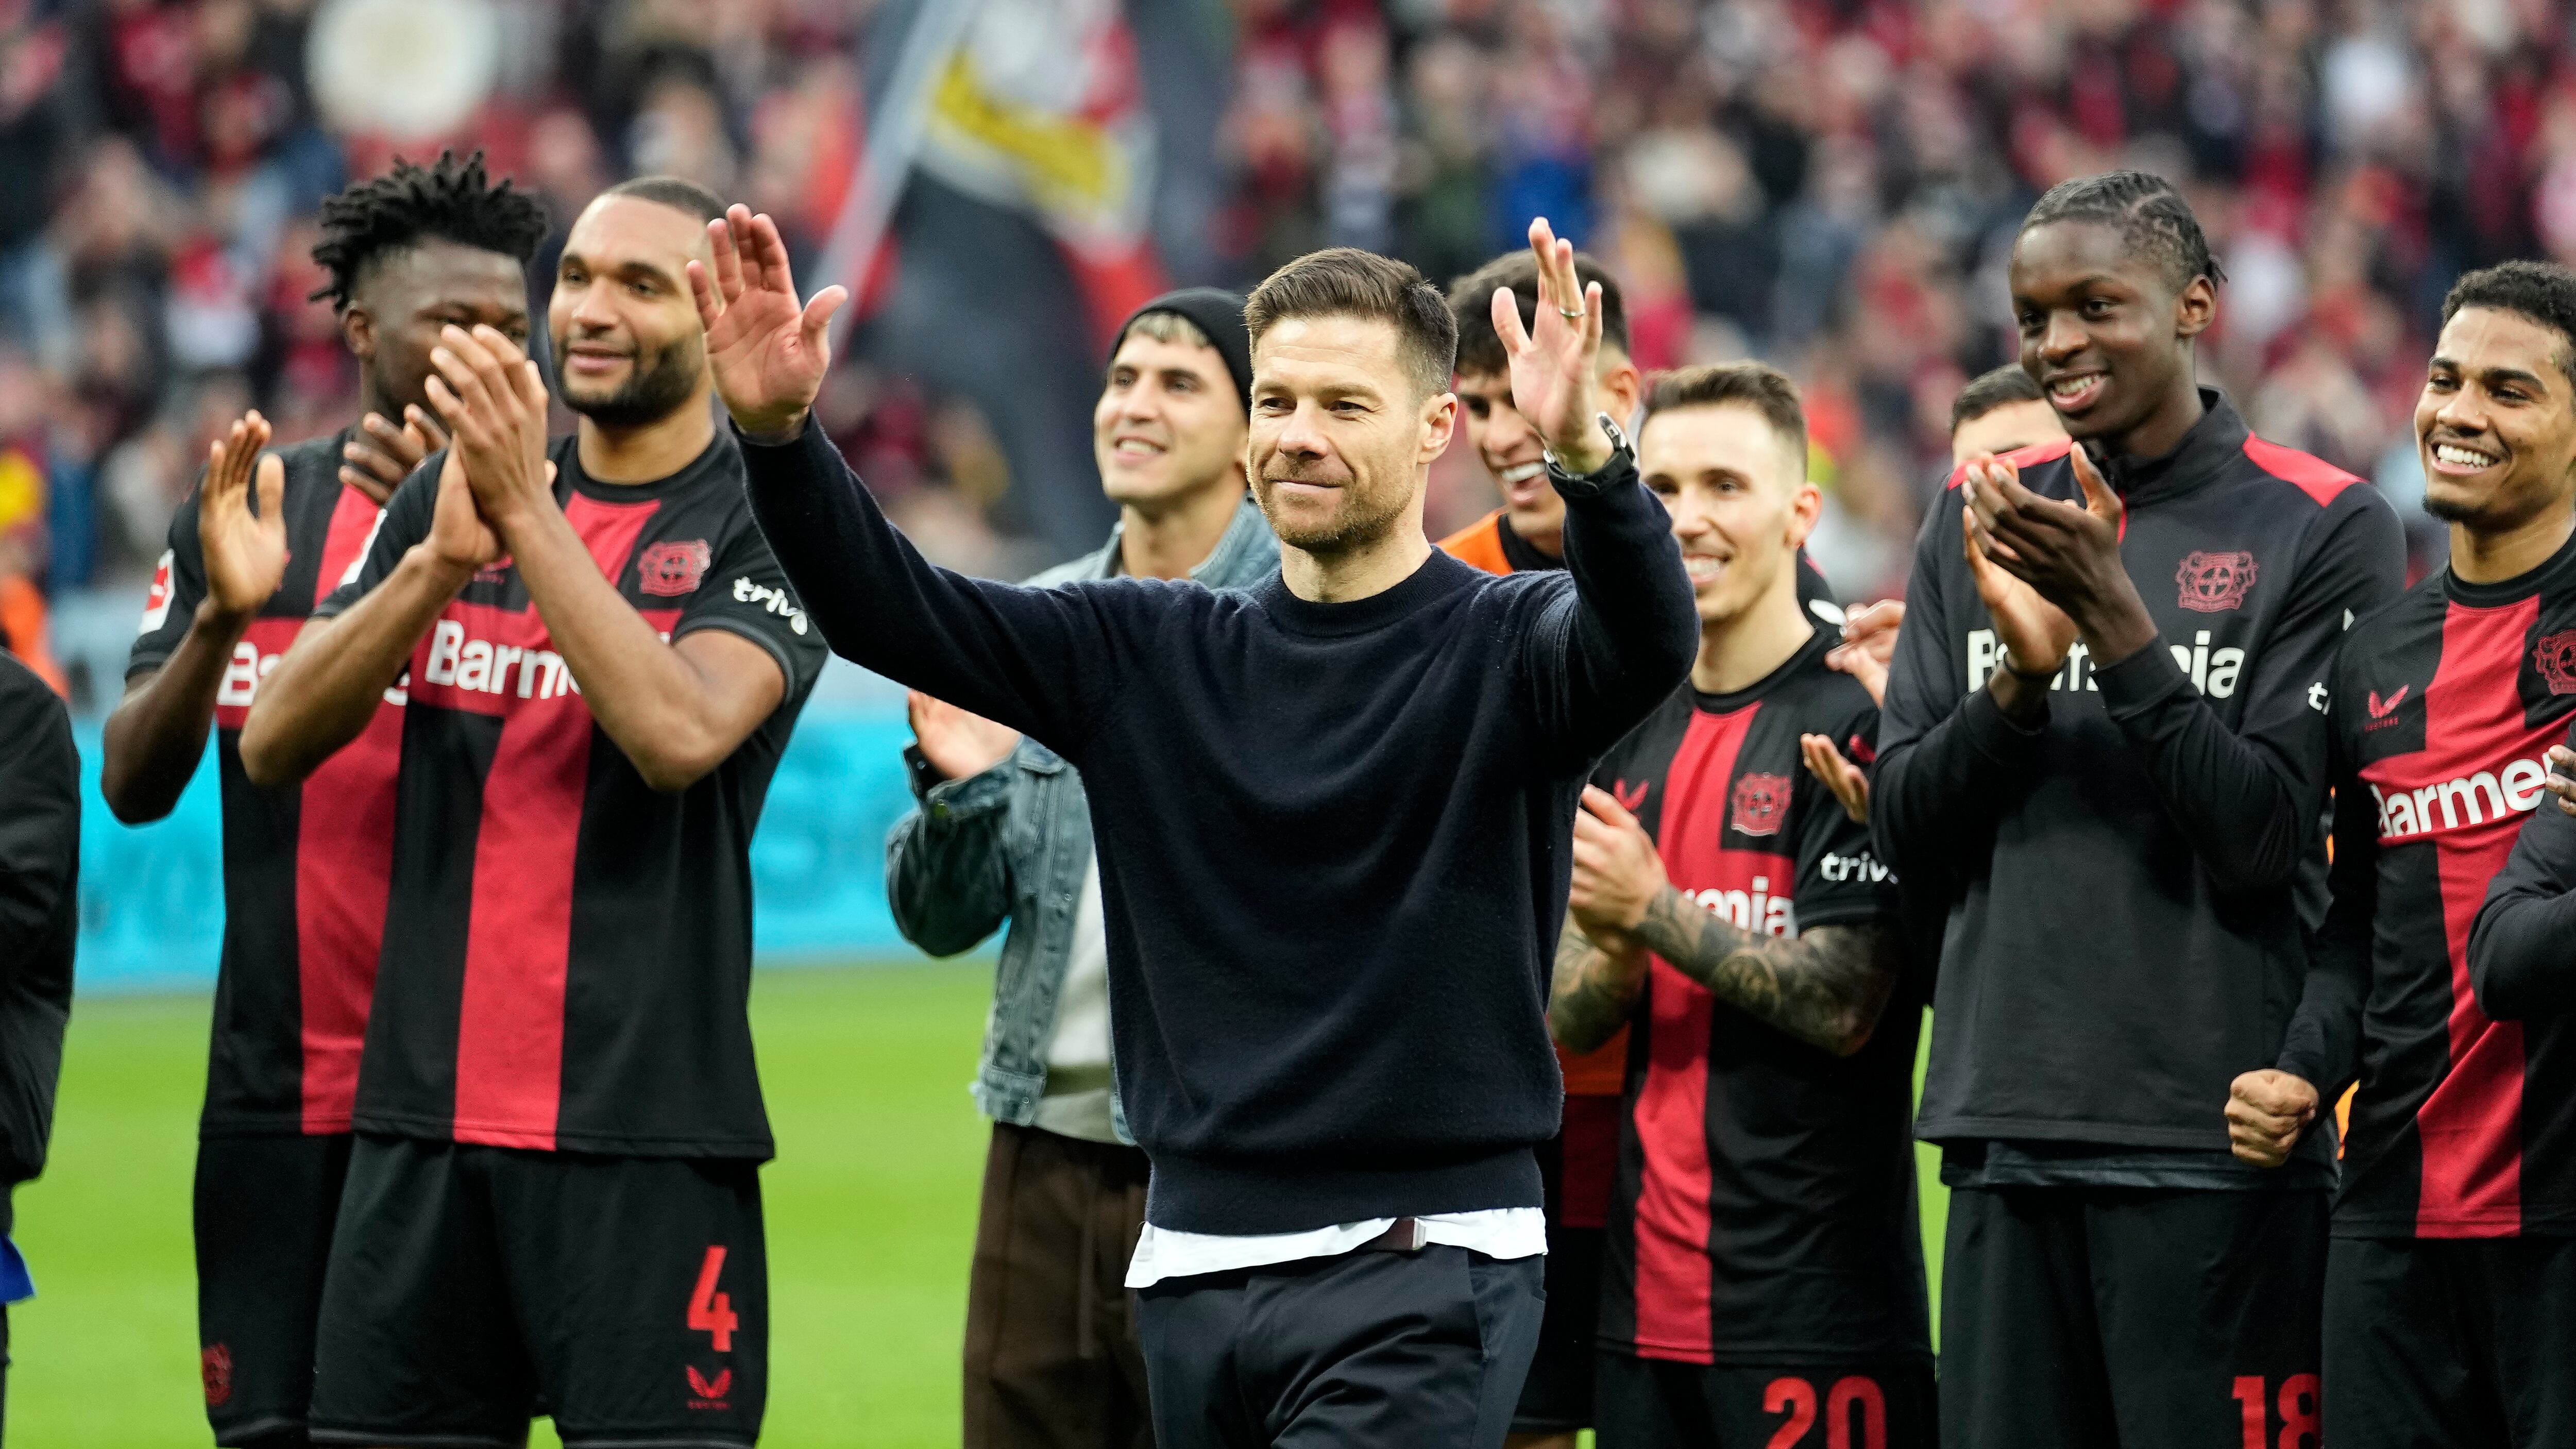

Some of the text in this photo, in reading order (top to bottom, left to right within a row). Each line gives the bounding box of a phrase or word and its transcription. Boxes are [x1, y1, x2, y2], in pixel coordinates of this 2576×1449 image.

[425, 619, 582, 700] Barm
[2369, 752, 2554, 838] arme
[1820, 851, 1899, 884] triv
[687, 1244, 738, 1352] 4
[1762, 1376, 1887, 1449] 20
[2231, 1373, 2321, 1449] 18
